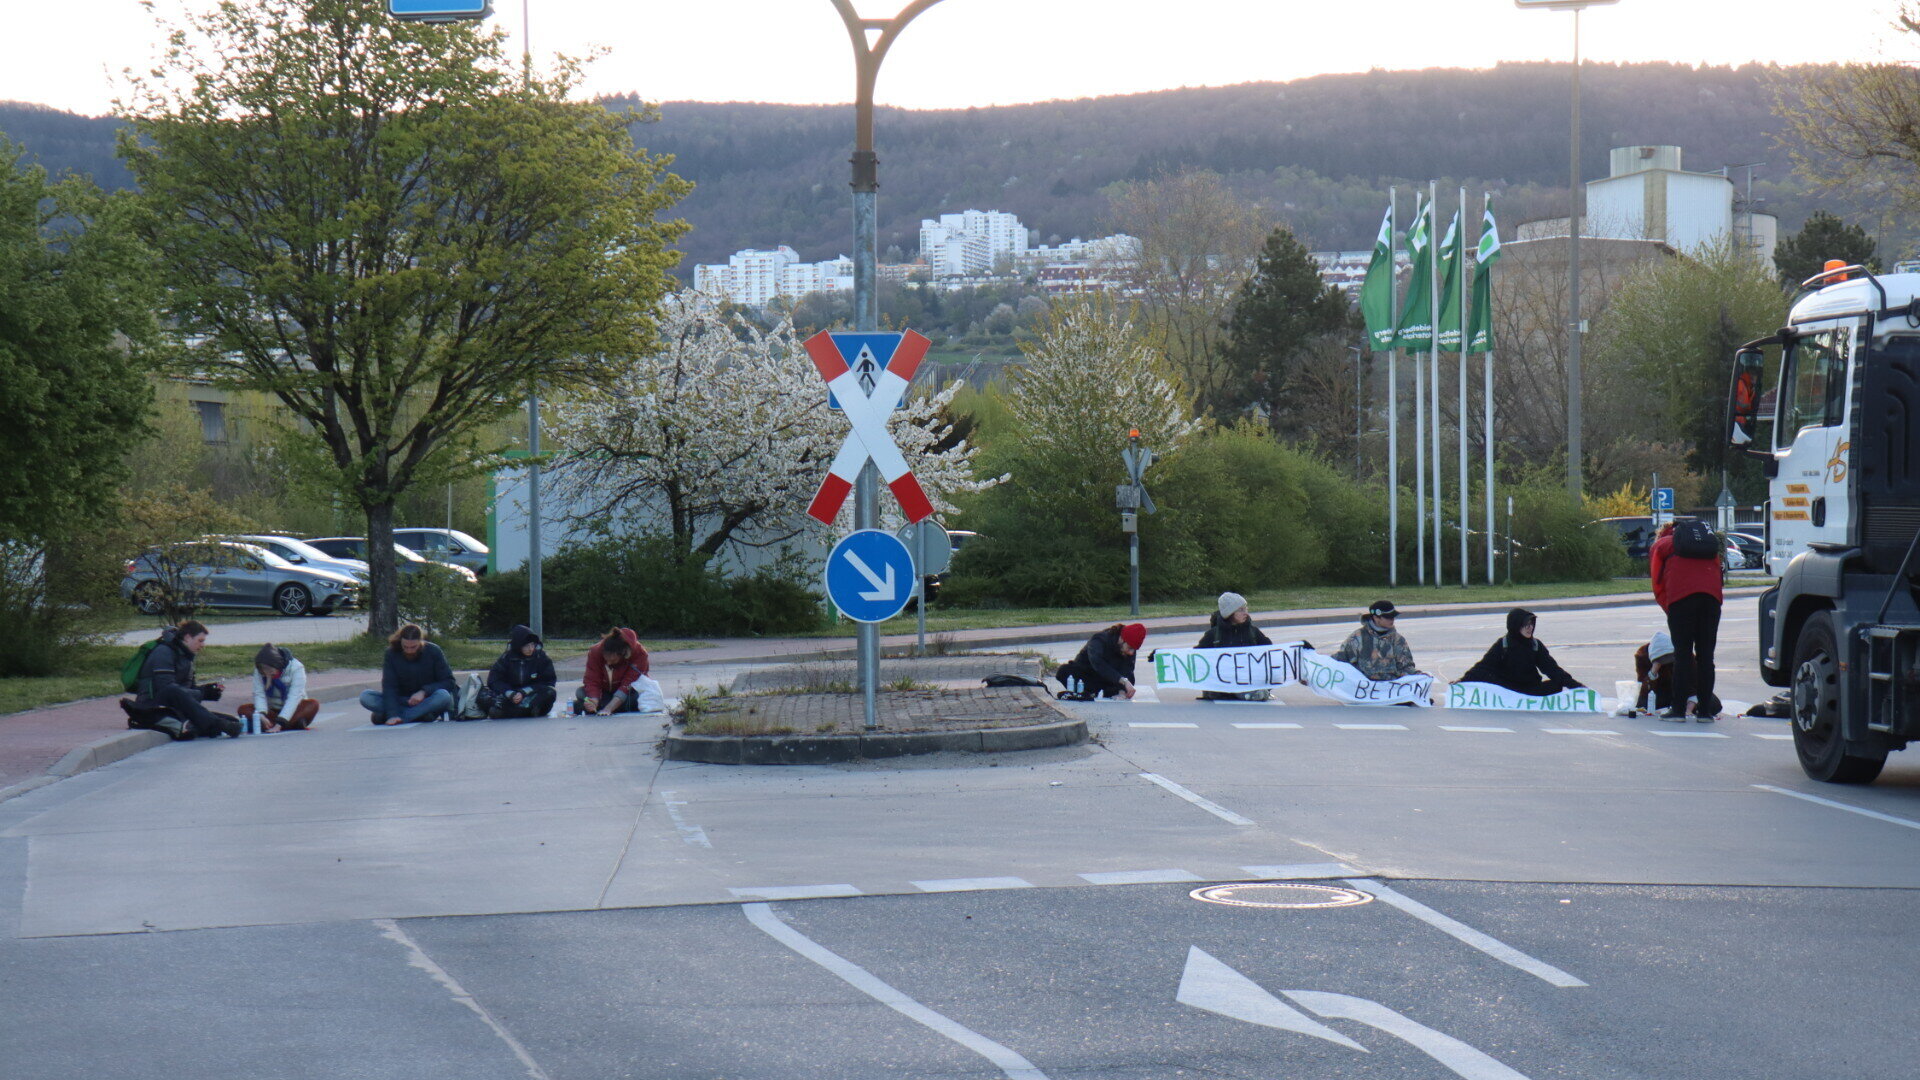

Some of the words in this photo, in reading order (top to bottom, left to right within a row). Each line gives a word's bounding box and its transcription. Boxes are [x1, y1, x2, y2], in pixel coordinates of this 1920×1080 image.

[1155, 652, 1210, 683] END
[1215, 645, 1303, 685] CEMENT
[1302, 657, 1345, 690] STOP
